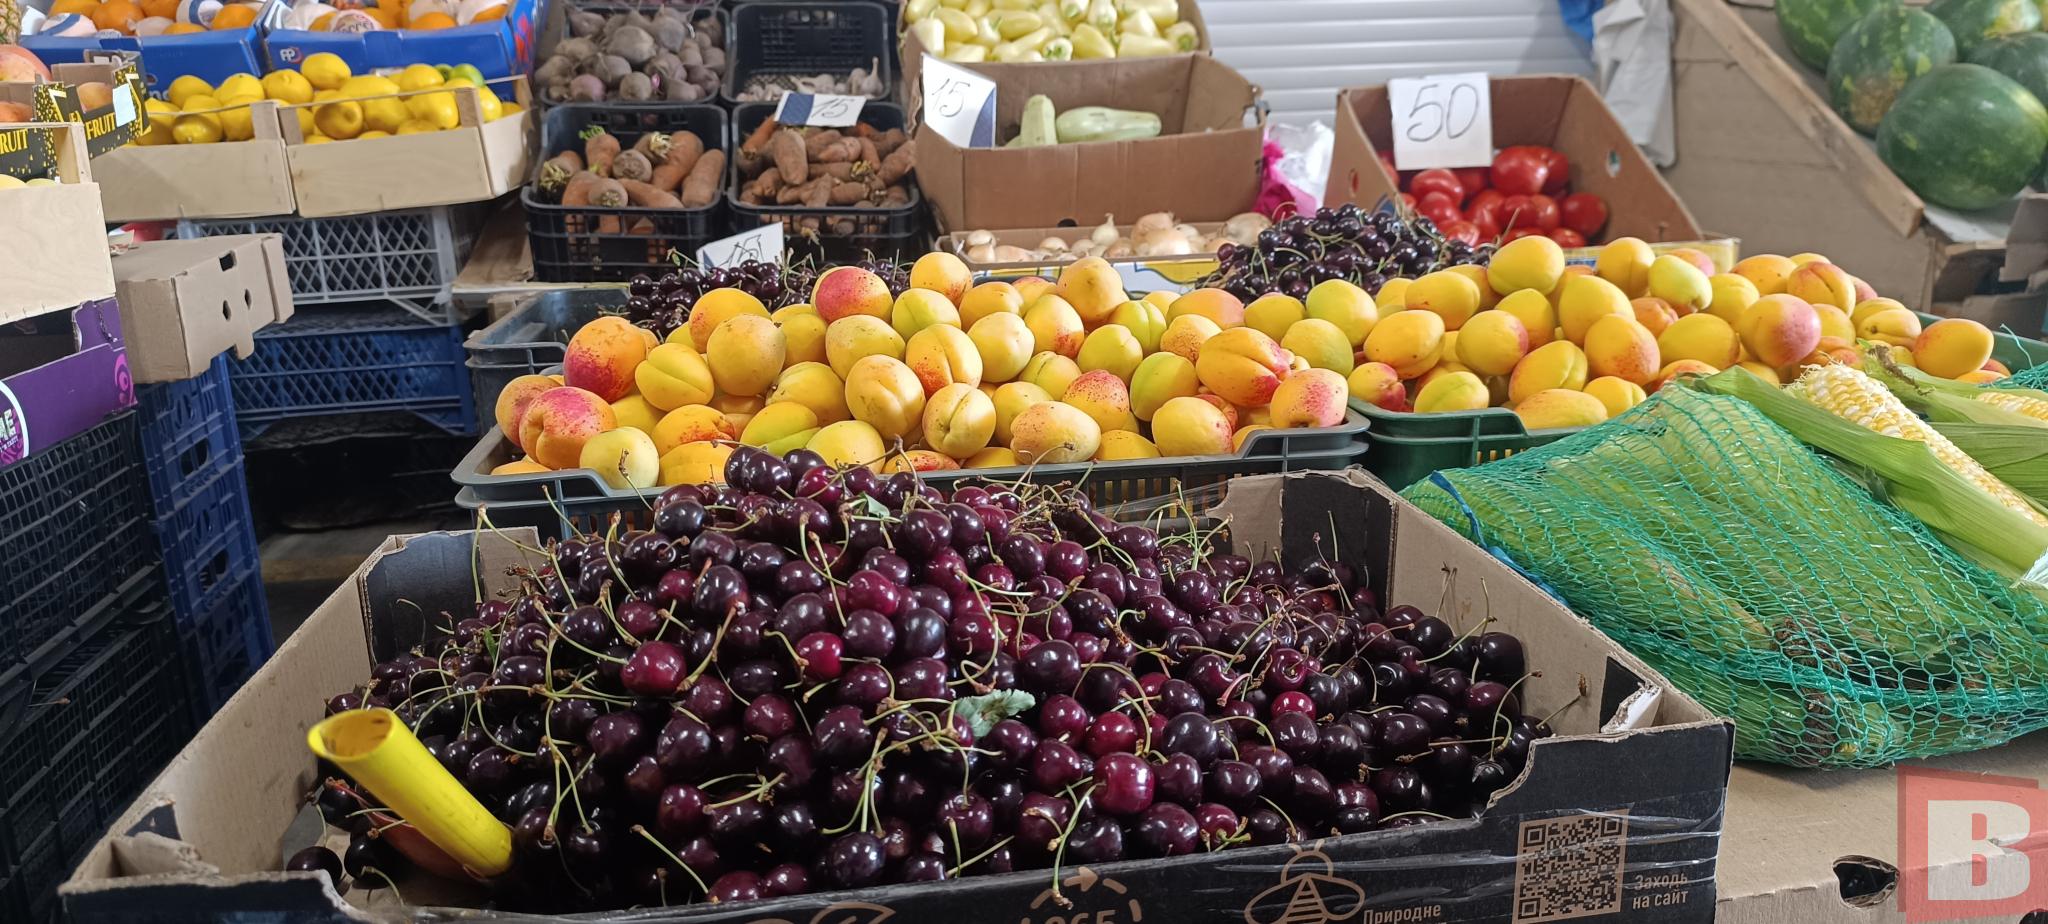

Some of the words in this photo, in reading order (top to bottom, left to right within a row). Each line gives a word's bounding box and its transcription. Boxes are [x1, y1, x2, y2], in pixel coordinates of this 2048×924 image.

[811, 97, 855, 118] 15
[931, 78, 971, 117] 15
[1406, 83, 1479, 142] 50
[85, 112, 116, 141] FRUIT
[0, 128, 28, 155] RUIT
[1635, 873, 1688, 890] Заходь
[1632, 895, 1650, 909] на
[1654, 888, 1688, 906] сайт
[1363, 904, 1441, 924] Природне
